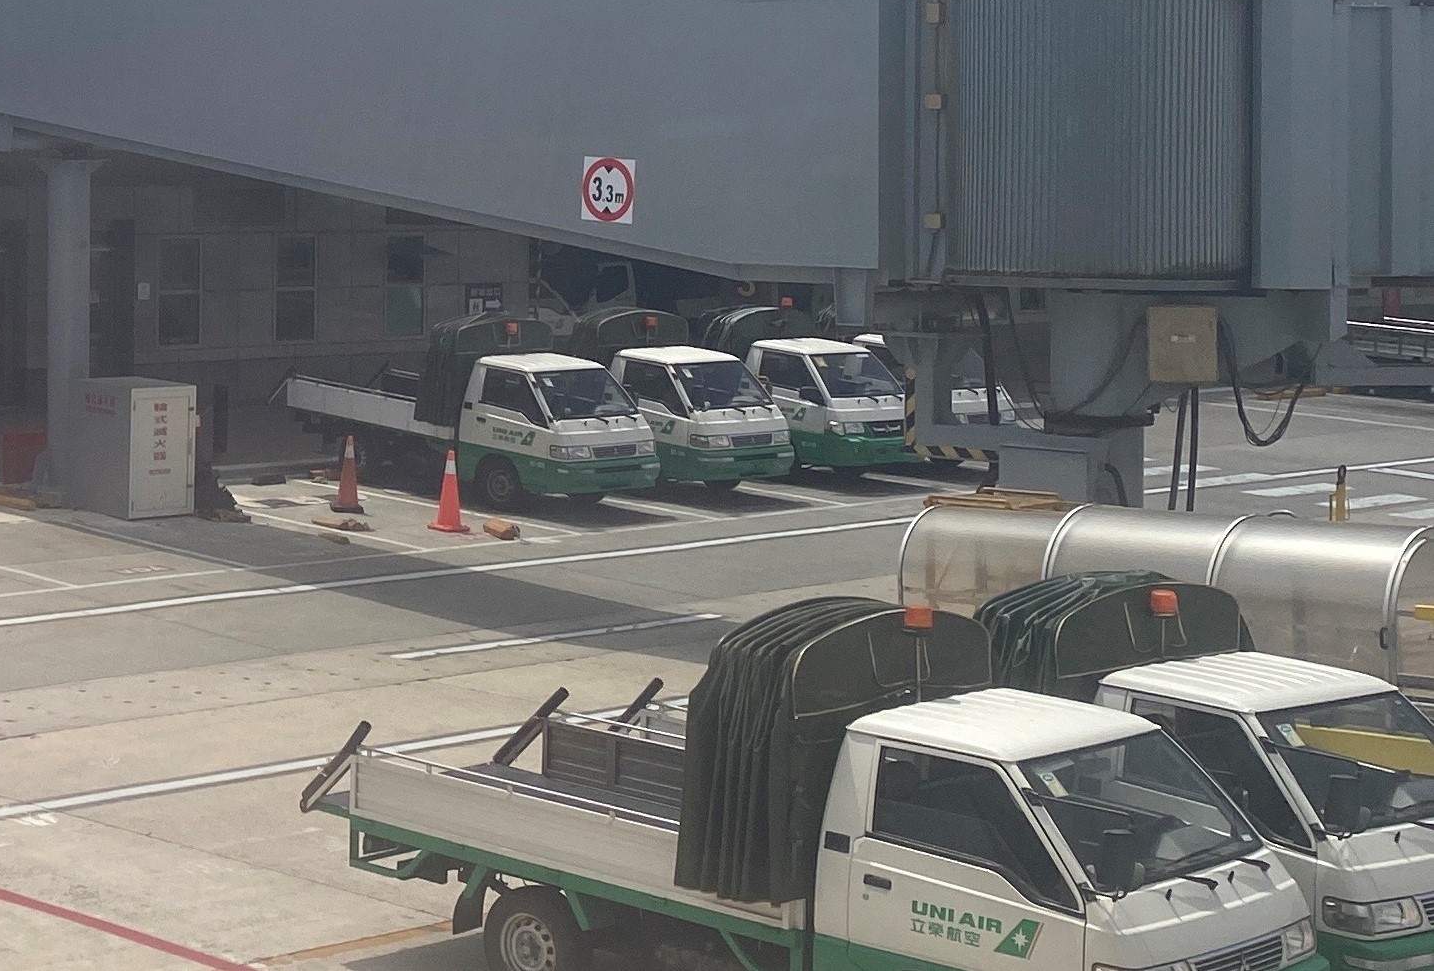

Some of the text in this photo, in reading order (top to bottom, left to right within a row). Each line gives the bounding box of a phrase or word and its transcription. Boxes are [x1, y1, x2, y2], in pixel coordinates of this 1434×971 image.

[911, 900, 1002, 934] UNI AIR
[911, 918, 980, 947] 立榮航空
